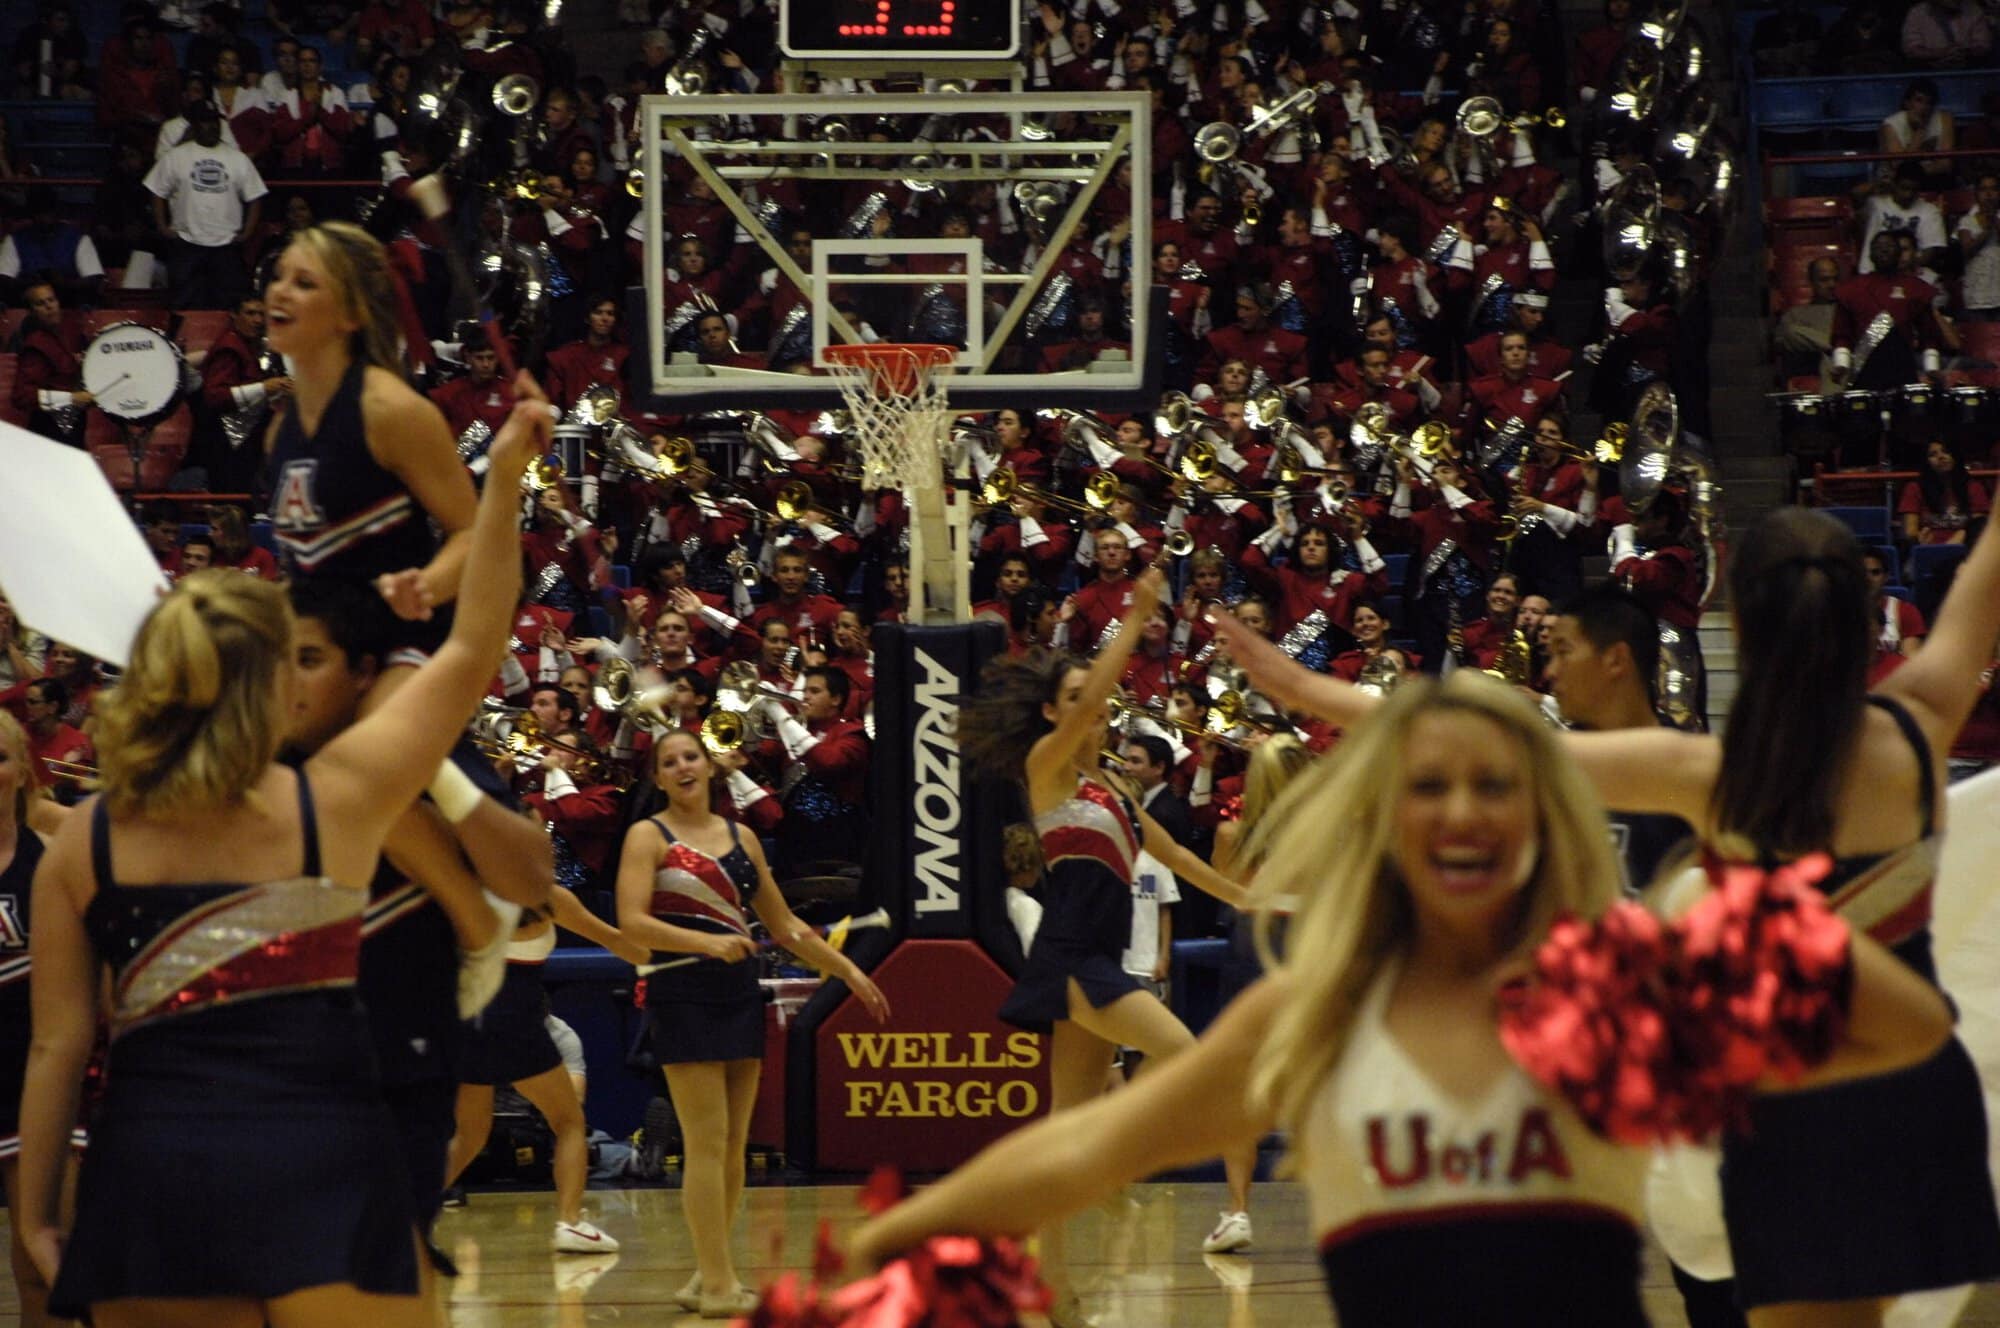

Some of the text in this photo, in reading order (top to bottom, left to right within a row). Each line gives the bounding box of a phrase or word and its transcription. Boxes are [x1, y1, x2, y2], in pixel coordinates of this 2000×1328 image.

[914, 646, 960, 912] ARIZONA
[837, 1031, 1041, 1069] WELLS
[844, 1079, 1039, 1119] FARGO
